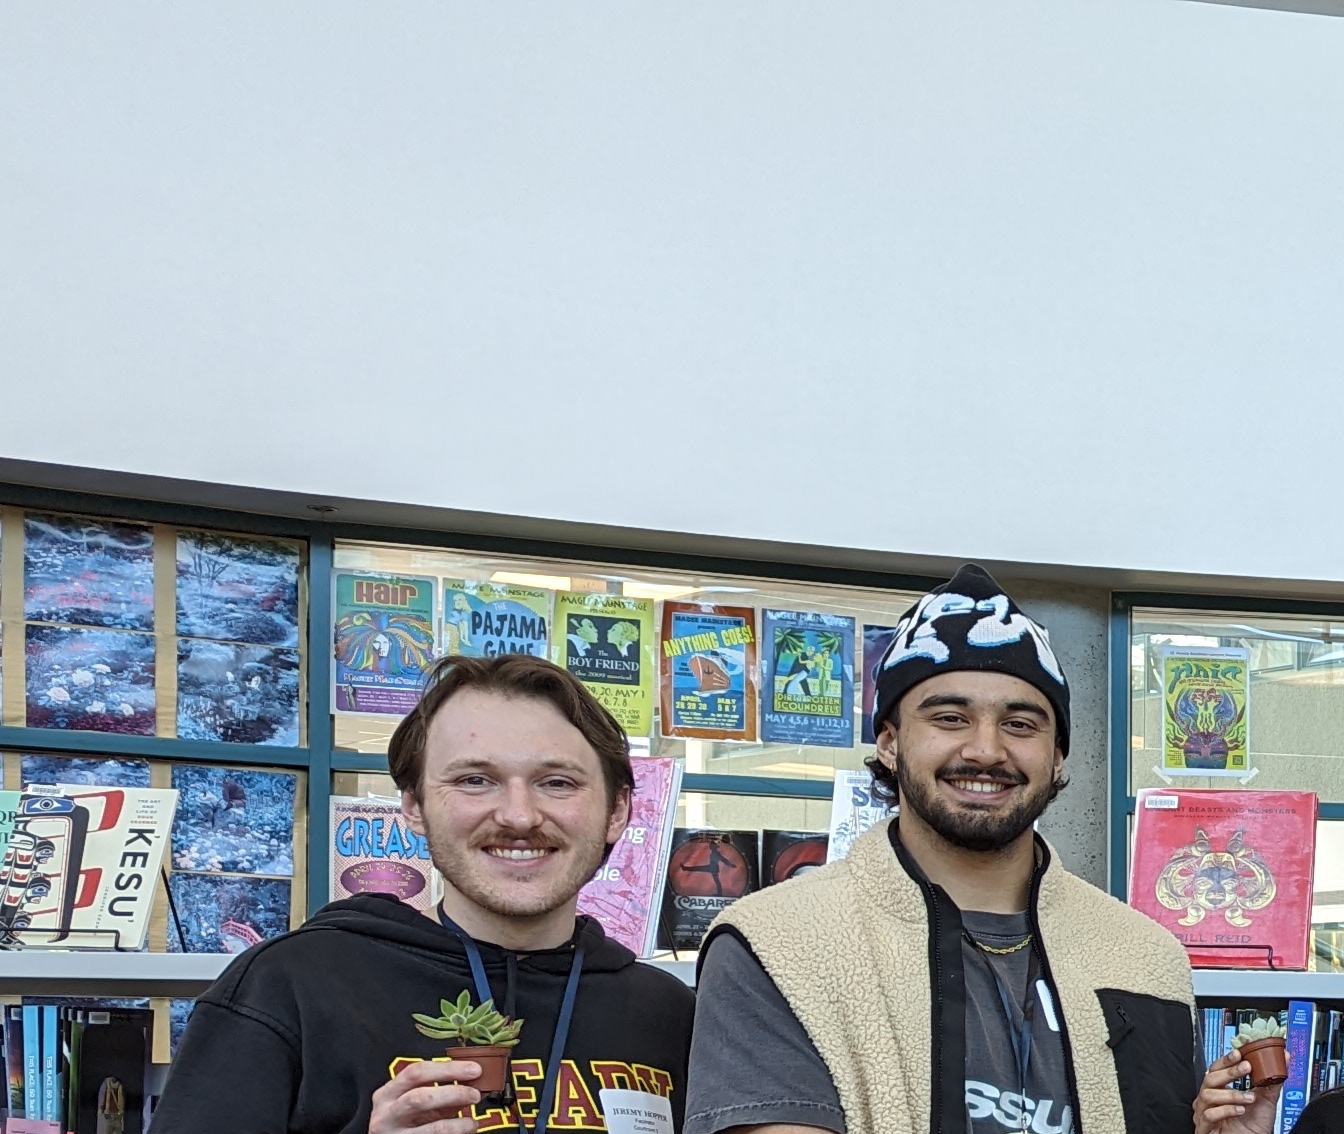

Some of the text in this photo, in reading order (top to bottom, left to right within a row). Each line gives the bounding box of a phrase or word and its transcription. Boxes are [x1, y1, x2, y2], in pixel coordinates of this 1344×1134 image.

[354, 580, 418, 608] Hair
[494, 602, 507, 611] THE
[472, 610, 547, 641] PAJAMA
[484, 640, 534, 657] GAME
[663, 625, 755, 658] ANYTHING GOES!
[568, 656, 640, 672] BOY FRIEND
[615, 688, 638, 698] MAY
[778, 701, 840, 715] SCOUNDRELS
[765, 713, 785, 723] MAY
[336, 816, 431, 860] GREASE
[1214, 934, 1252, 944] REID
